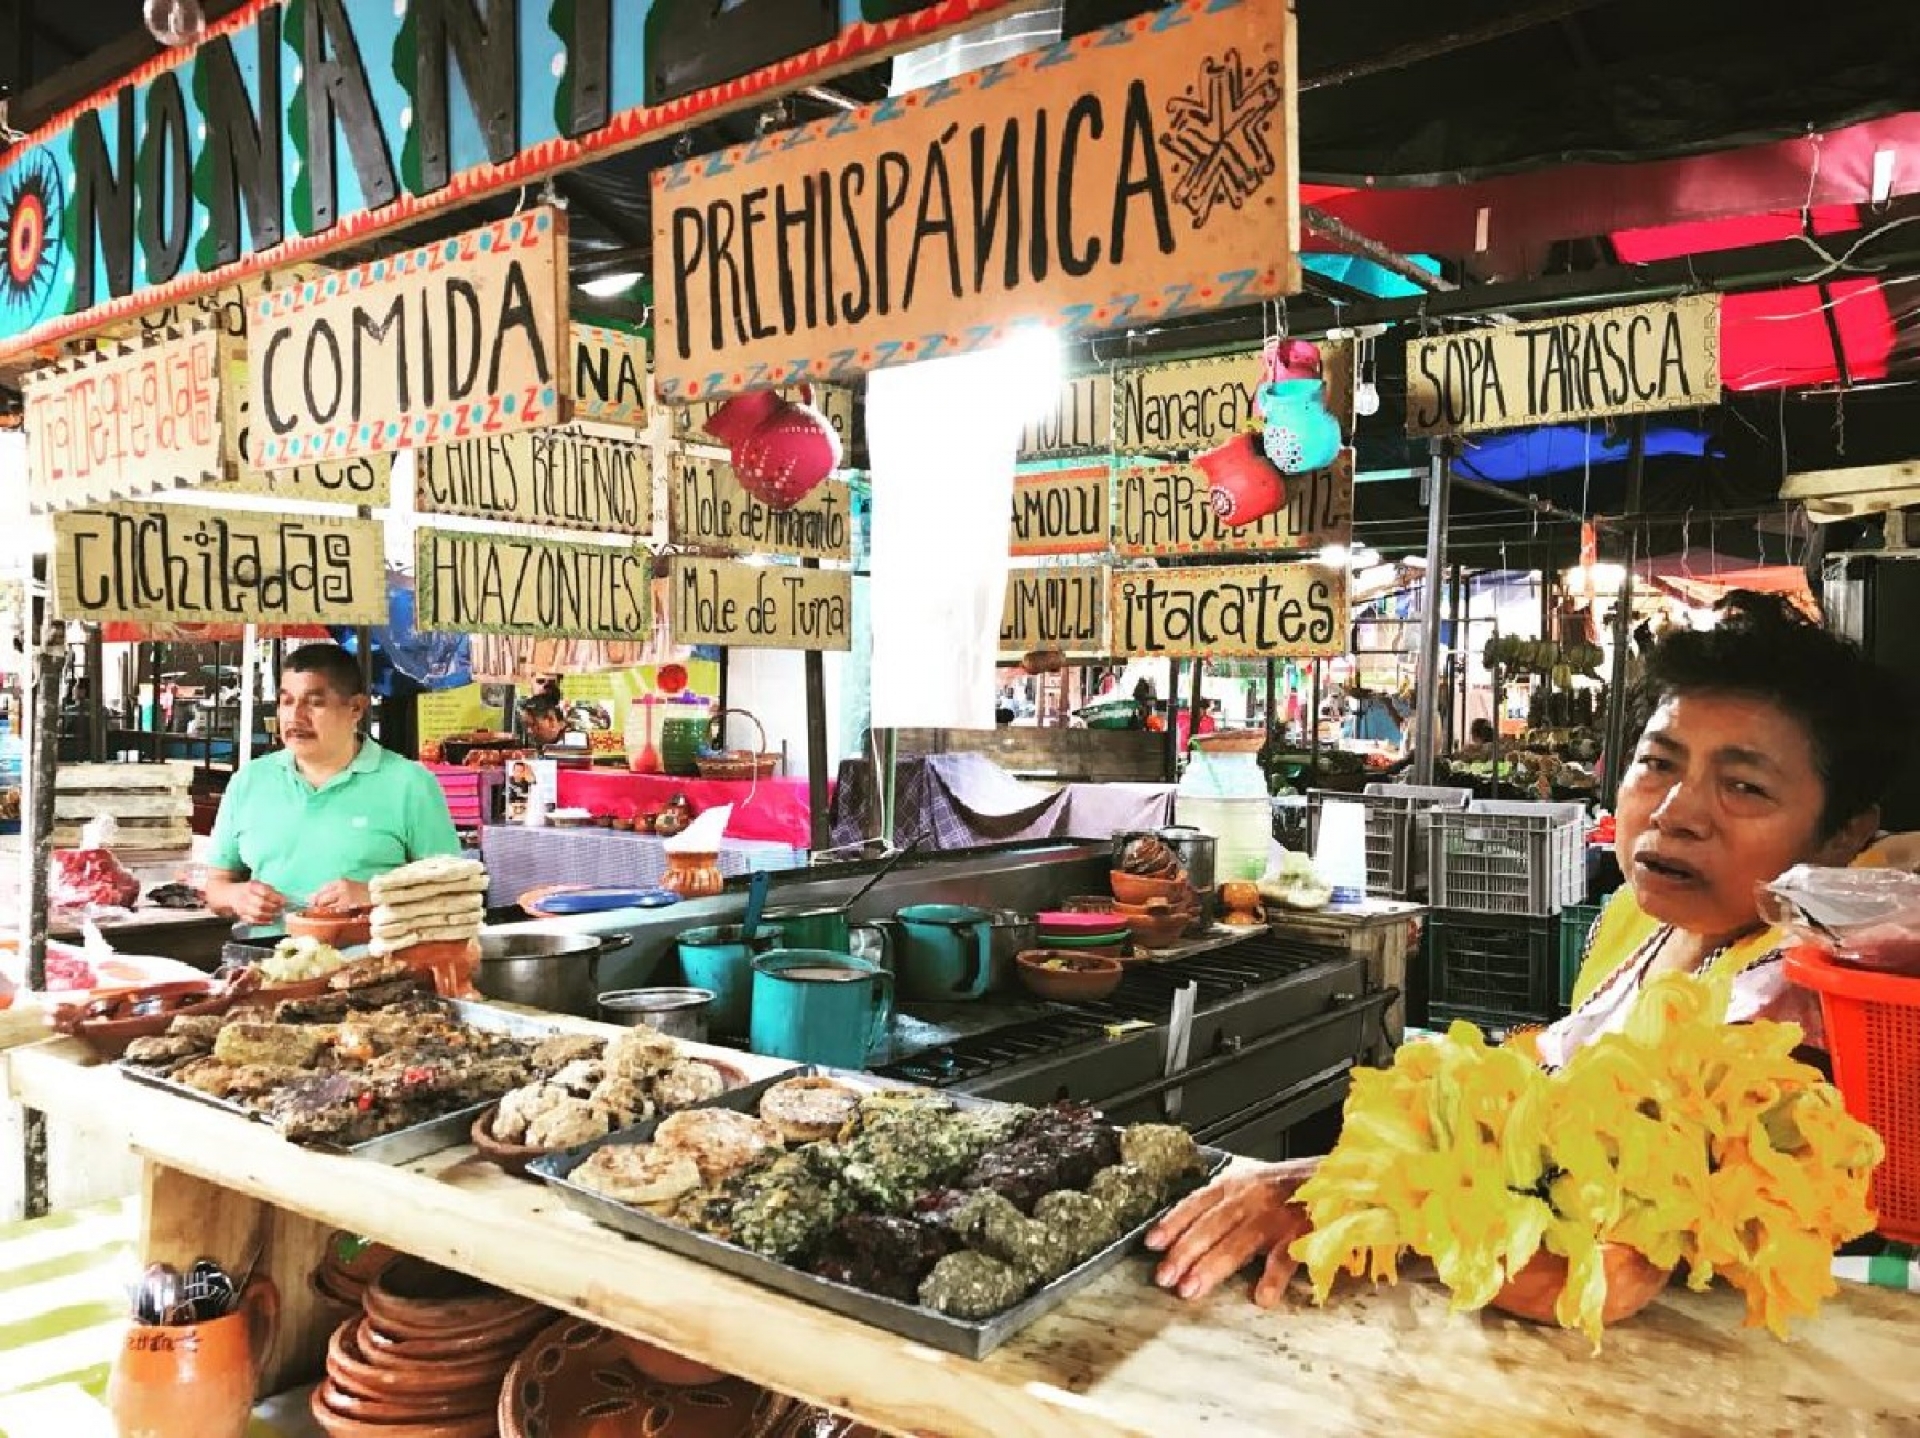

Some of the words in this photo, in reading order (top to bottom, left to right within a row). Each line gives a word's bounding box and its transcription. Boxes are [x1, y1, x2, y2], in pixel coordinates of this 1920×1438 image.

[672, 79, 1176, 359] PREHISPÁNICA
[263, 260, 550, 434] COMIDA
[1418, 335, 1506, 427] SOPA
[1515, 311, 1690, 415] TARASCA
[427, 432, 518, 511] CHILES
[431, 536, 641, 632] HUAZONTLES
[683, 566, 738, 633] Mole
[748, 570, 777, 635] de
[782, 576, 844, 639] Tuna
[1122, 575, 1335, 651] itacates
